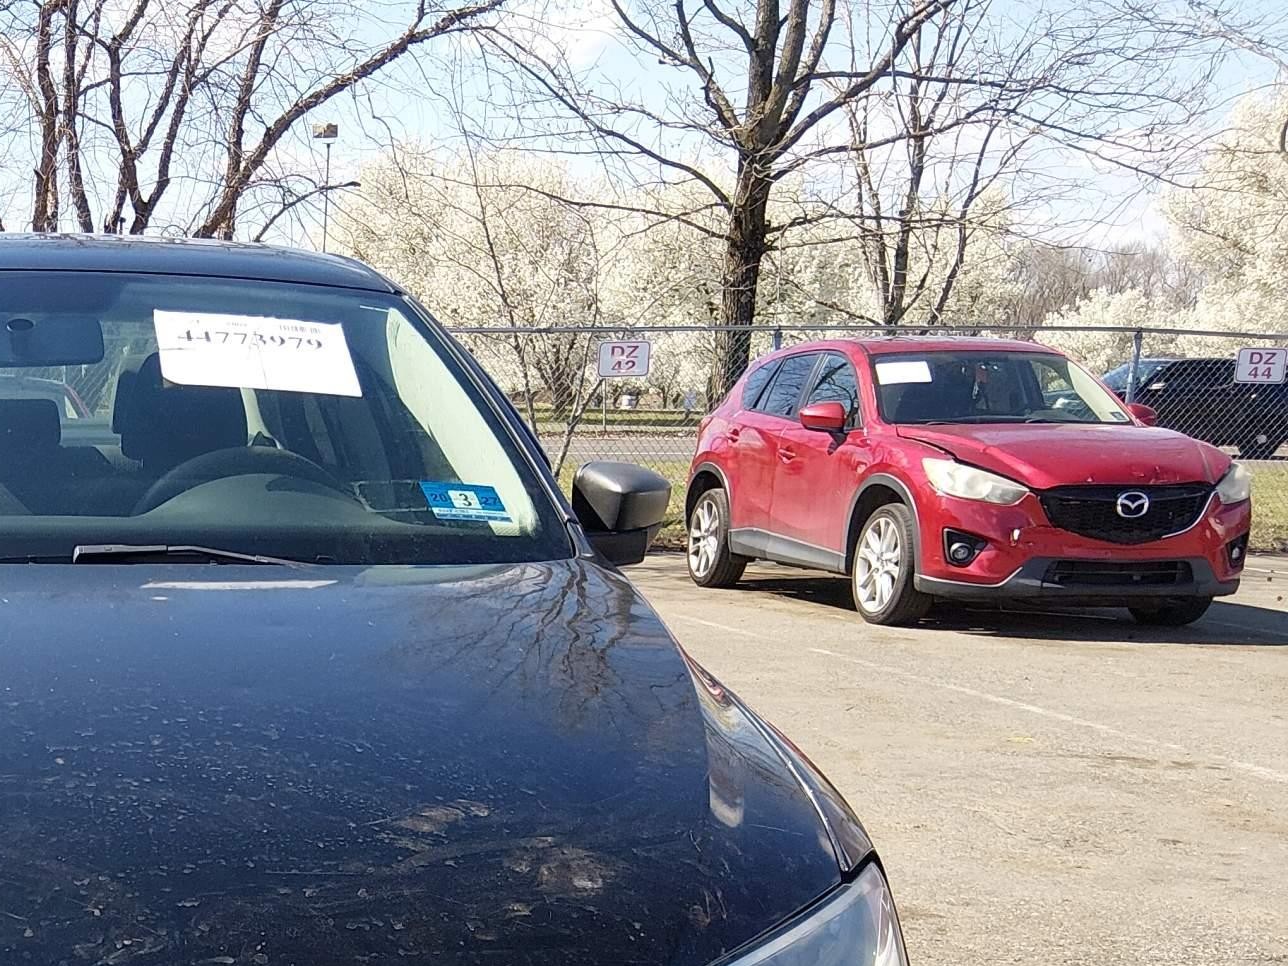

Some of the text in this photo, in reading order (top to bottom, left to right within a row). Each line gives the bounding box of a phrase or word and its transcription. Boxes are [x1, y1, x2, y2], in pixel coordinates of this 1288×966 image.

[177, 329, 324, 350] 44773979
[611, 345, 639, 359] DZ
[1249, 352, 1277, 365] DZ
[611, 360, 636, 373] 42
[1248, 366, 1272, 379] 44
[459, 493, 472, 507] 3
